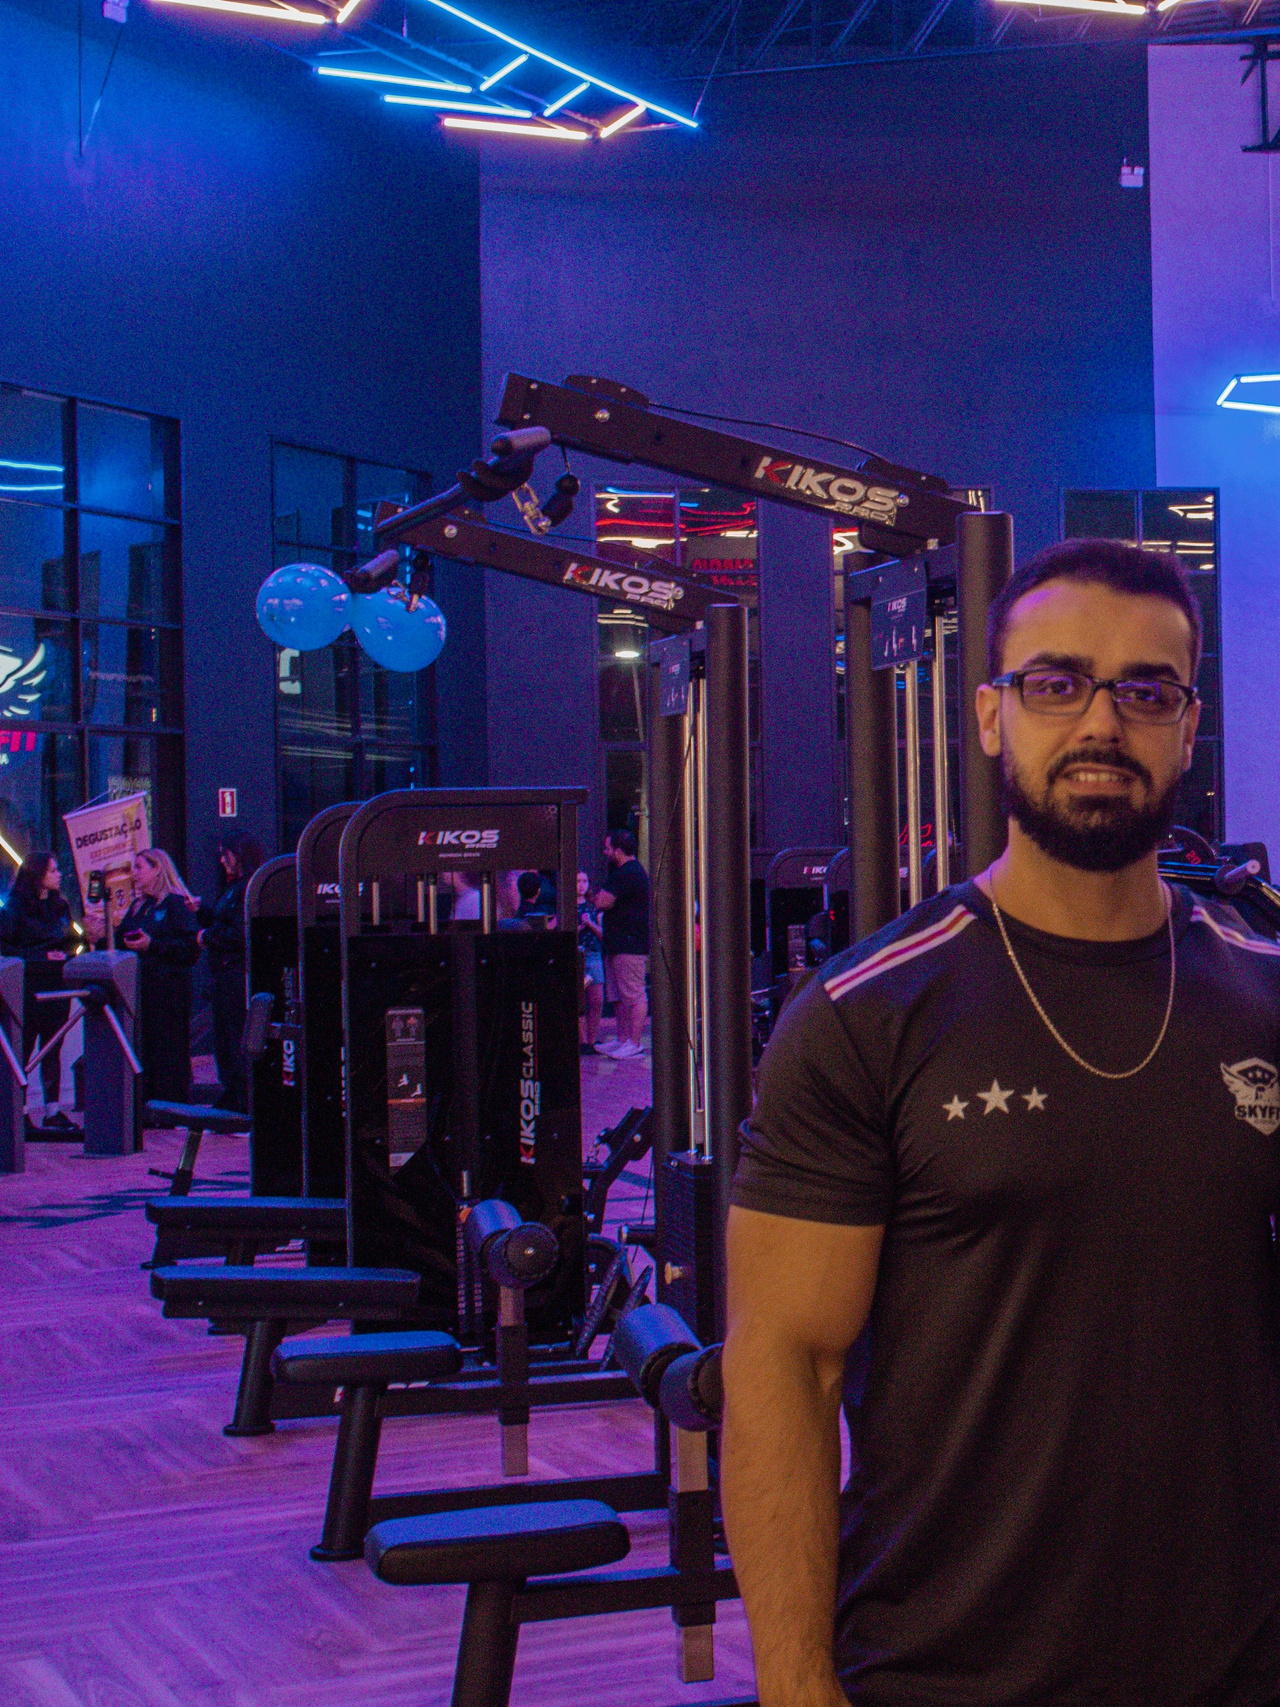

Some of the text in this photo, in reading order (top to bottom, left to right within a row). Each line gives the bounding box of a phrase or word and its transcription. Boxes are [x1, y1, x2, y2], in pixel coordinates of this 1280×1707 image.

[754, 456, 899, 512] KIKOS
[834, 501, 890, 522] PRO
[563, 562, 676, 600] KIKOS
[418, 829, 500, 845] KIKOS
[282, 1040, 295, 1087] KIKO
[520, 1001, 536, 1165] KIKOS CLASSIC
